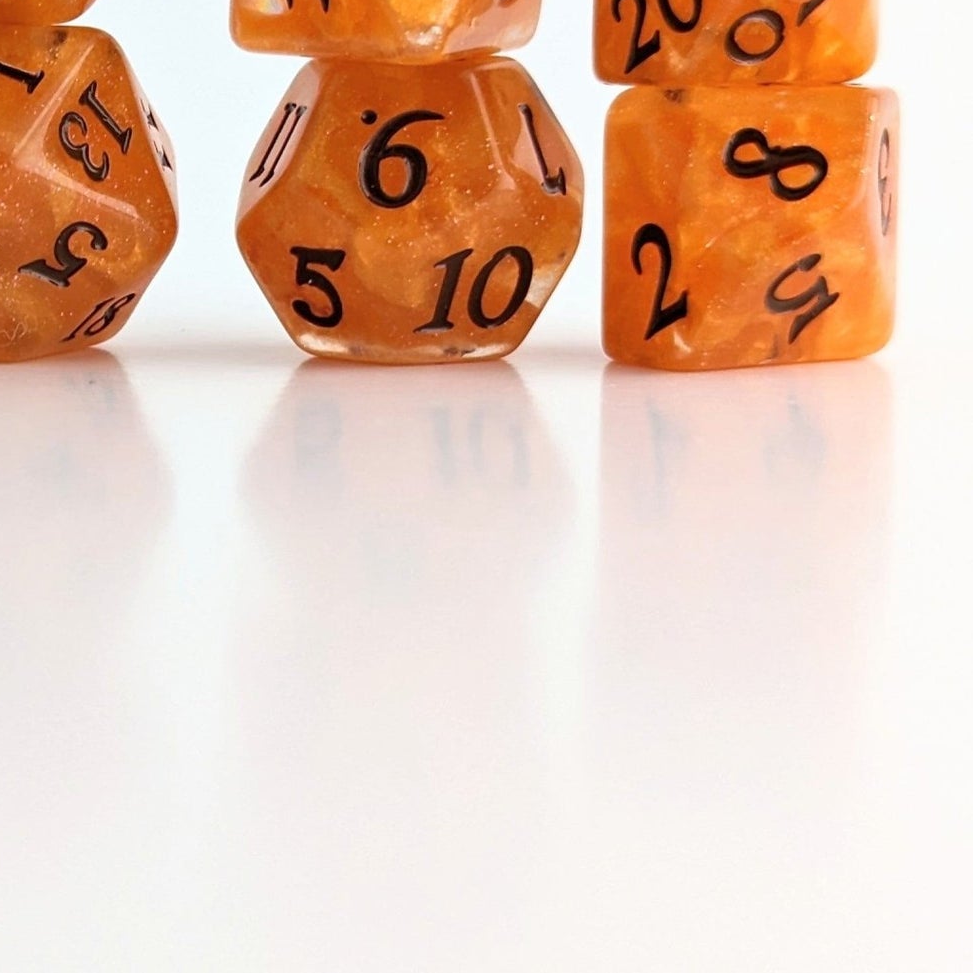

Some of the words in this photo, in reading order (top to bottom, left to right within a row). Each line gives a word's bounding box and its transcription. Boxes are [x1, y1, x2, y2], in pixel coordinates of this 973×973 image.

[58, 80, 132, 182] 13
[723, 127, 828, 201] 8
[18, 220, 108, 287] 5
[290, 246, 346, 328] 5
[413, 245, 534, 333] 10
[630, 223, 689, 340] 2
[766, 253, 839, 344] 5
